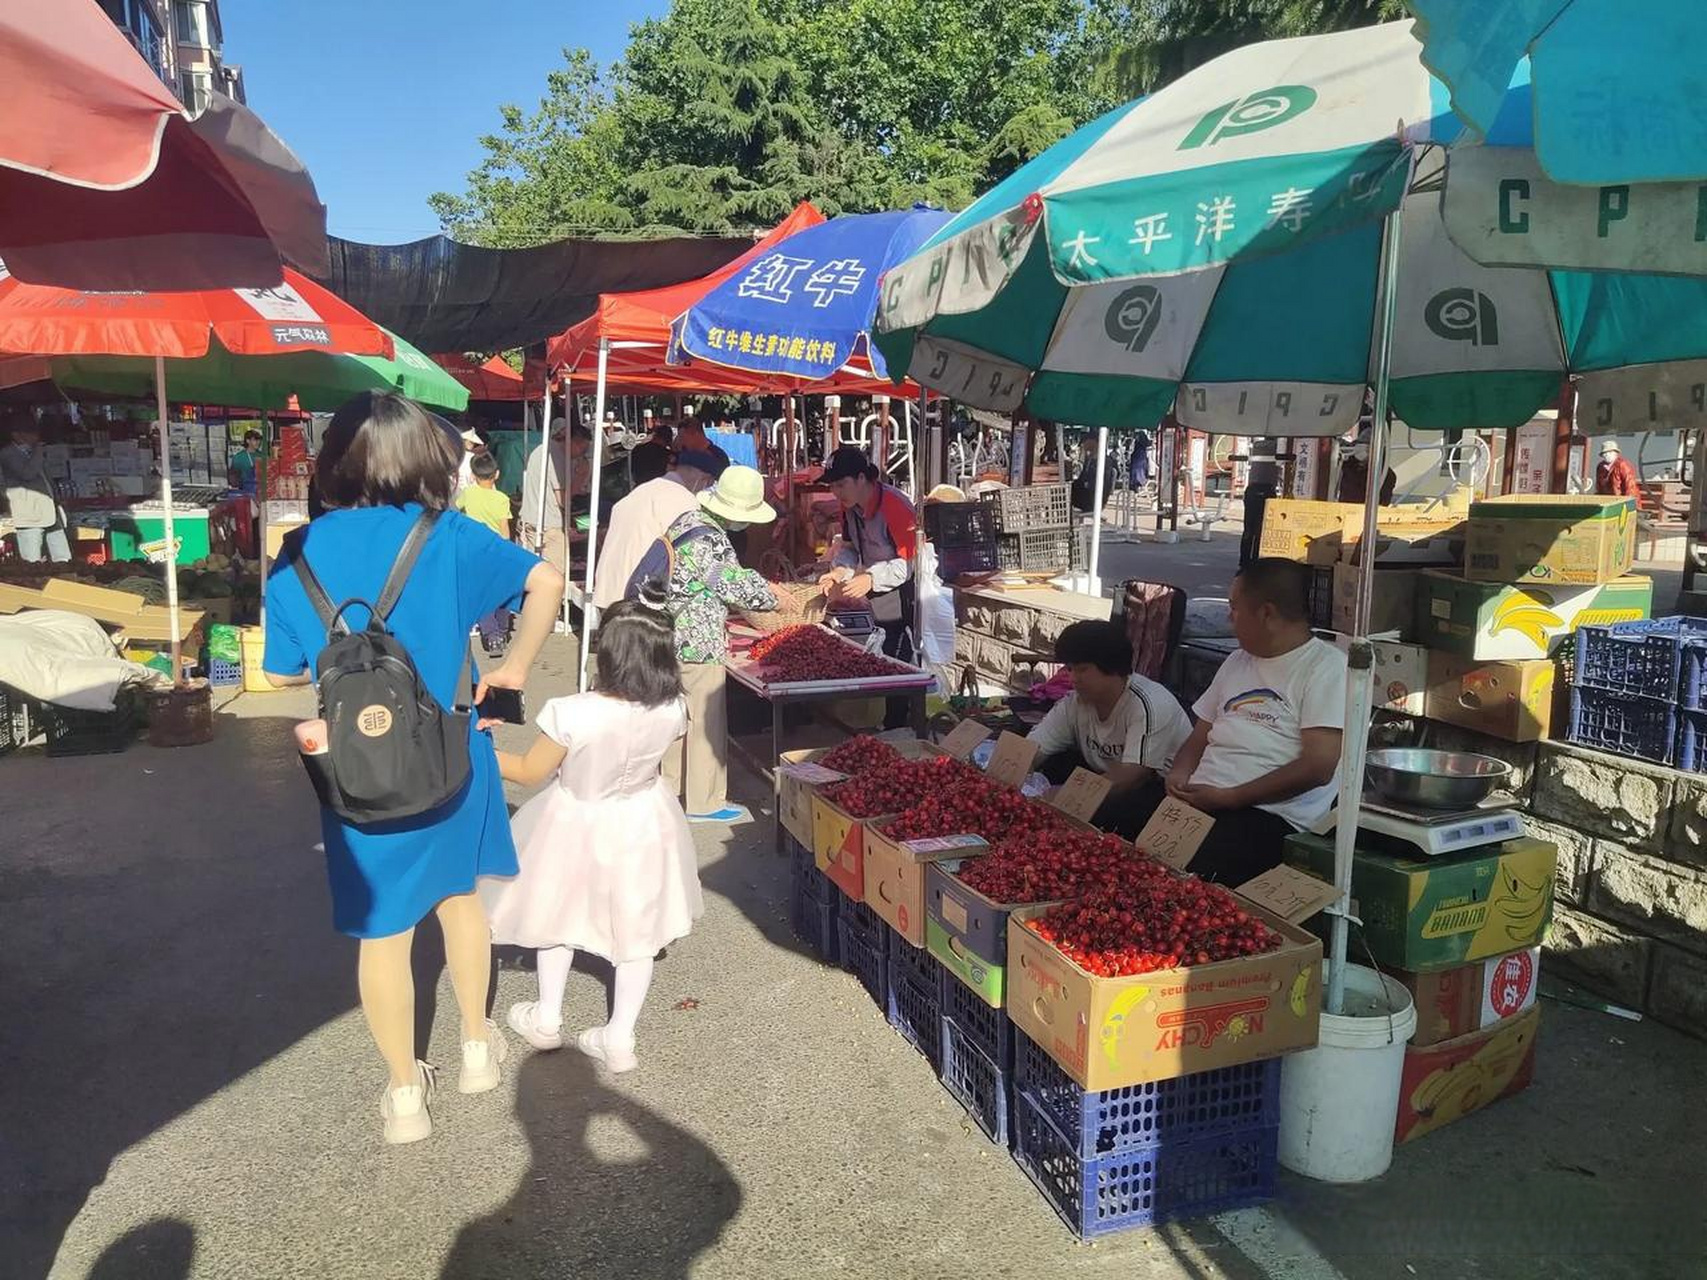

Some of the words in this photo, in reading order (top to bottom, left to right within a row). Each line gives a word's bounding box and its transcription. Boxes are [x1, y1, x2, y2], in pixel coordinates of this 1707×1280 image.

[738, 253, 867, 308] 红牛
[707, 326, 837, 365] 红牛维生素功能饮料
[1430, 906, 1487, 933] BANANA
[1160, 982, 1213, 998] Bananas
[1218, 972, 1272, 990] Premium
